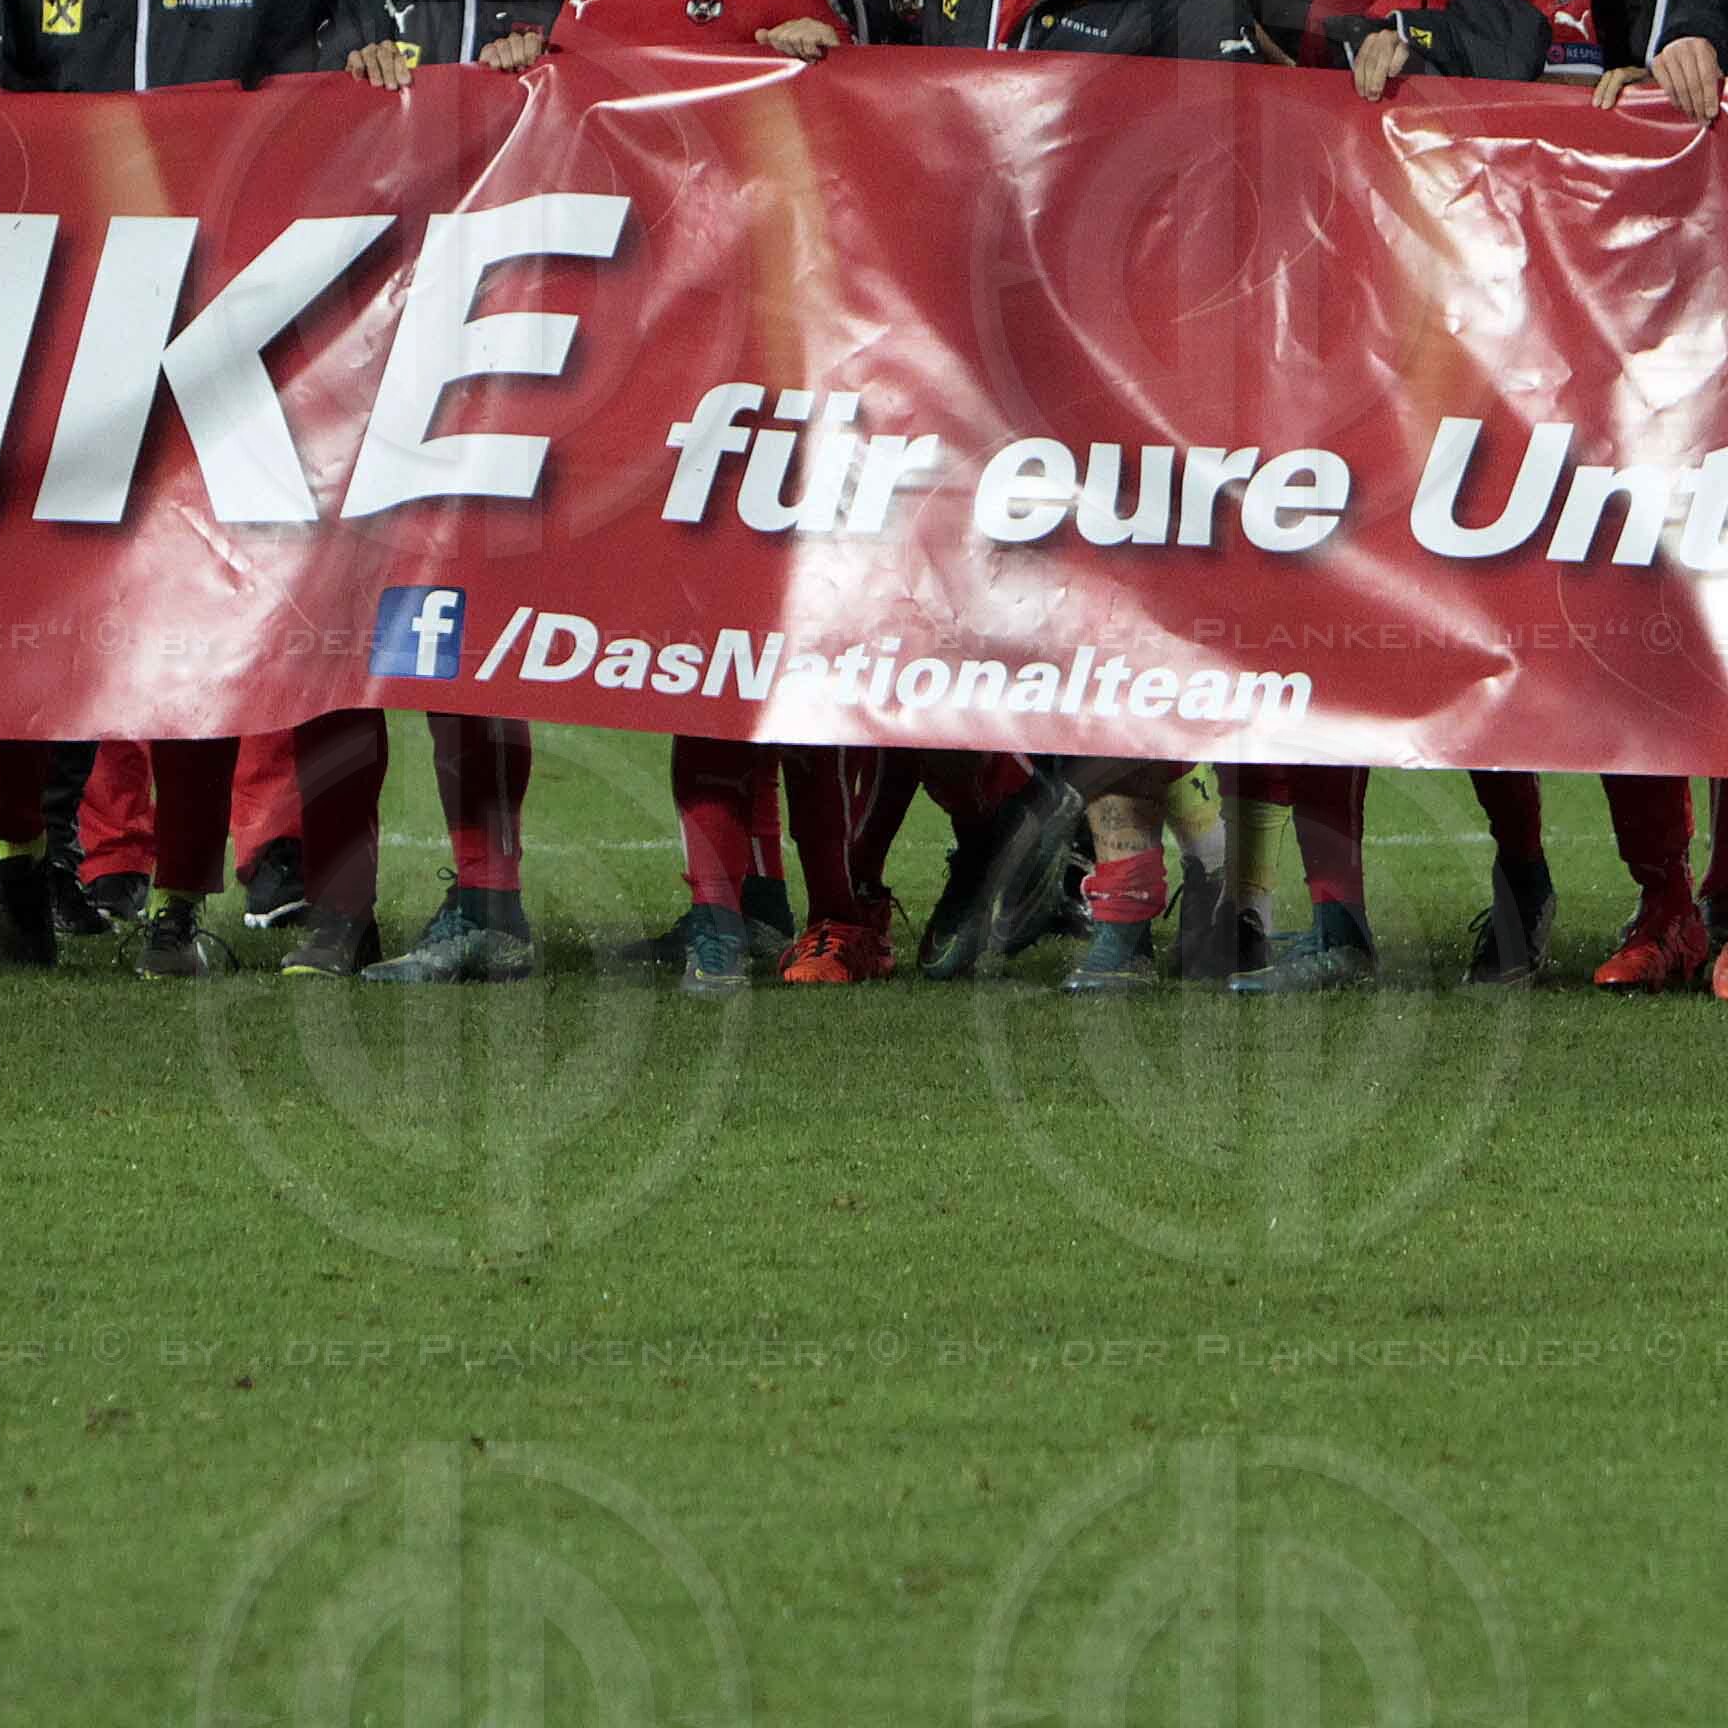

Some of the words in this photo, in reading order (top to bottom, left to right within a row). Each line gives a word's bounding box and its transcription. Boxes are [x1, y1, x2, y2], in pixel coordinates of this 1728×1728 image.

[660, 381, 940, 535] für
[972, 435, 1352, 553] eure
[475, 605, 1313, 725] /DasNationalteam
